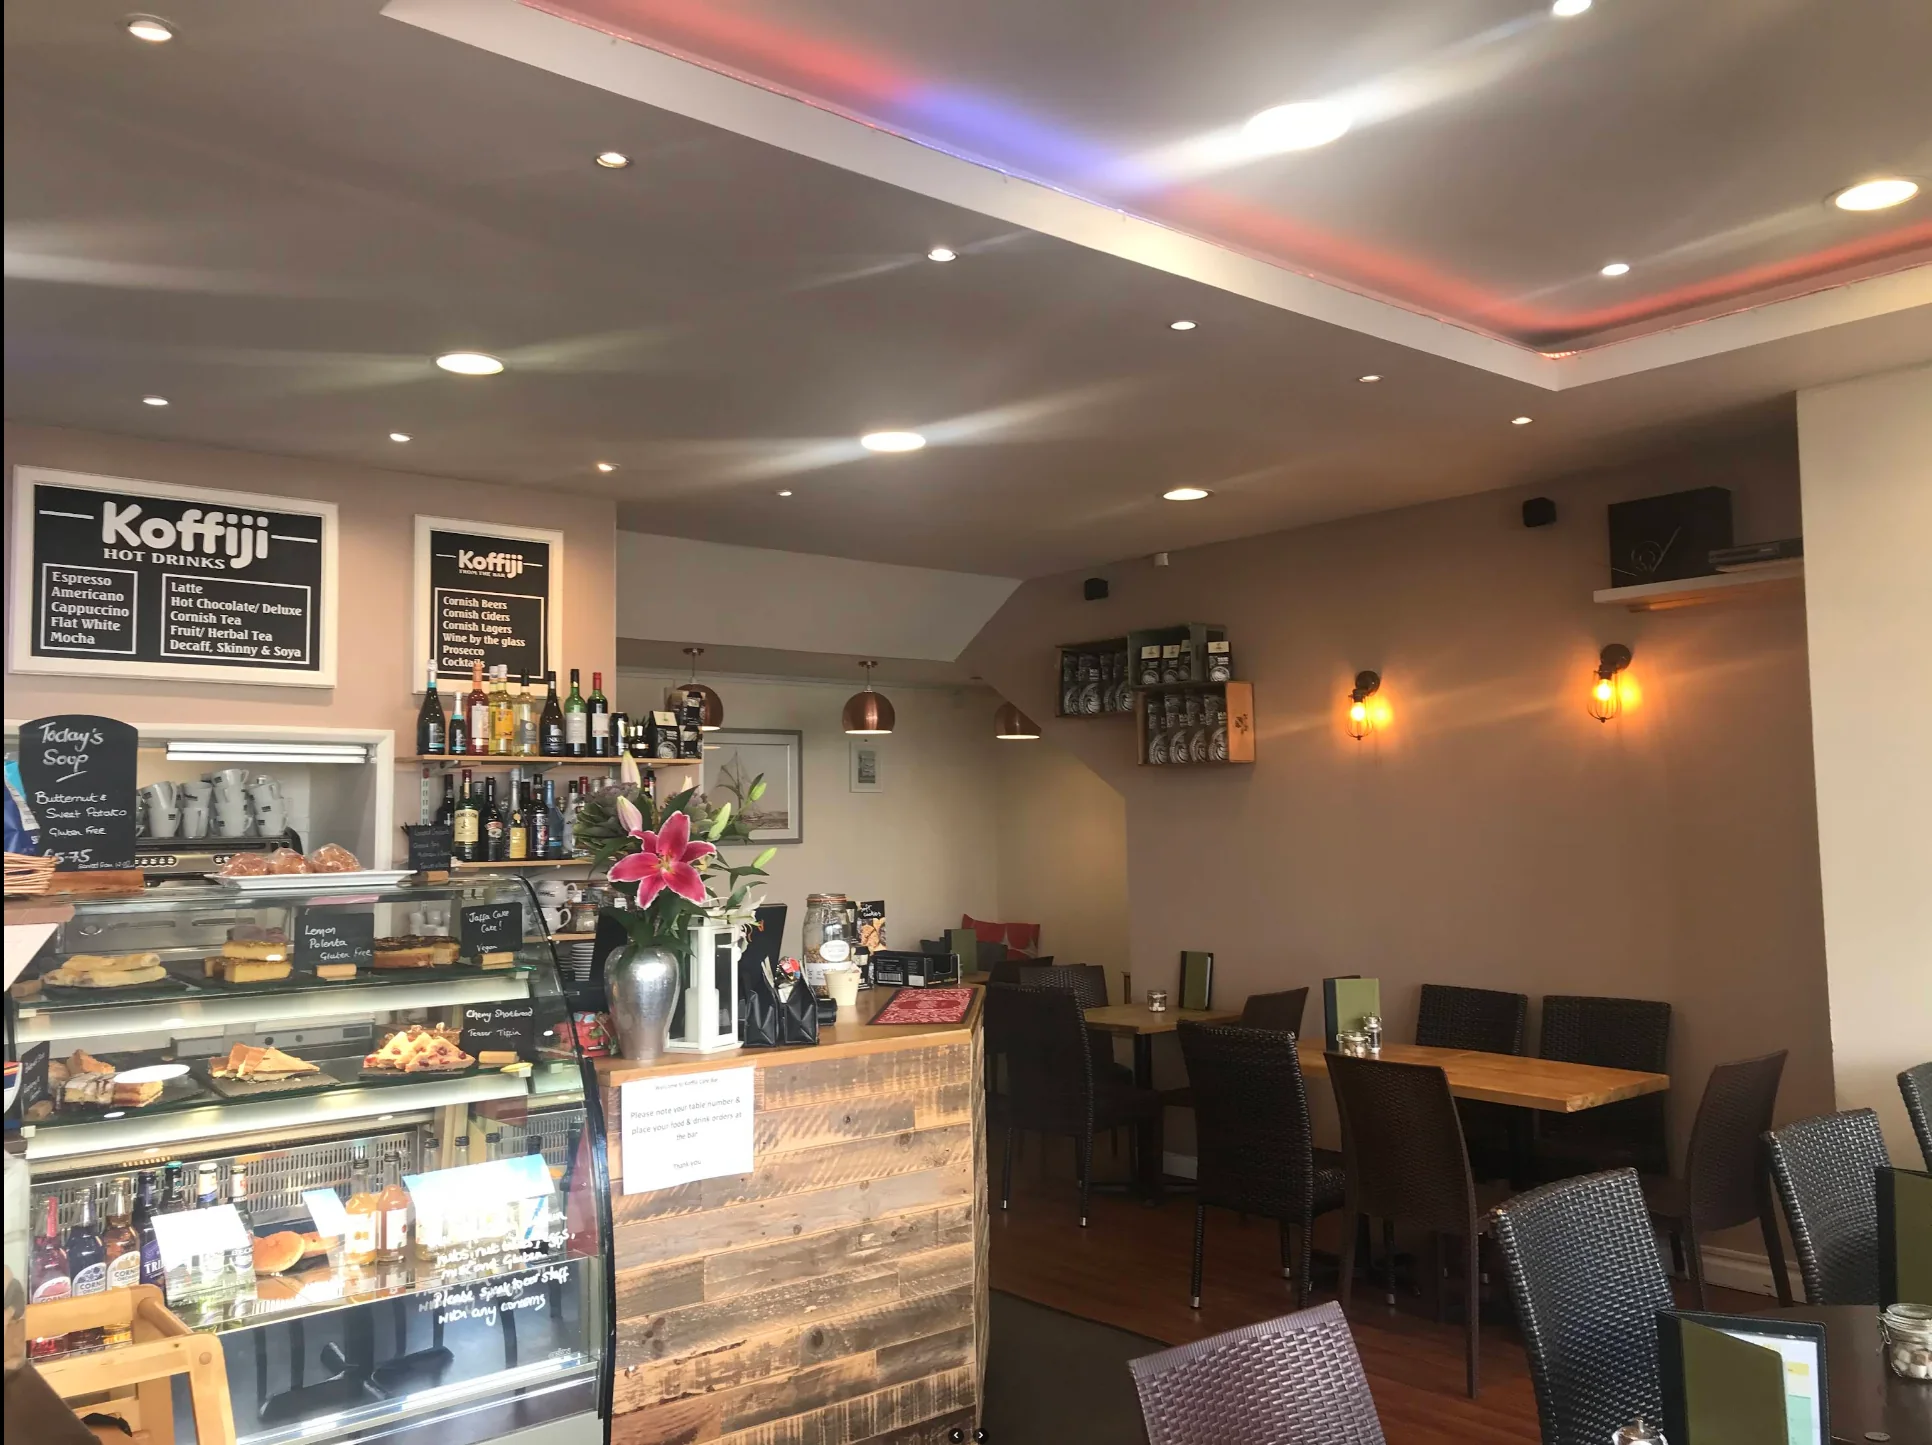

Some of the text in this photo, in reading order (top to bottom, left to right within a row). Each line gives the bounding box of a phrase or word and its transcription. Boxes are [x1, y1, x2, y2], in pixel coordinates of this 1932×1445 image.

[102, 501, 268, 569] Koffiji
[104, 548, 225, 570] HOT DRINKS
[459, 550, 523, 578] Koffiji
[52, 572, 112, 587] Espresso
[51, 587, 124, 601] Americano
[171, 582, 203, 594] Latte
[171, 597, 302, 616] Hot Chocolate/ Deluxe
[443, 596, 507, 609] Cornish Beers
[51, 602, 129, 618] Cappuccino
[443, 608, 510, 622] Cornish Ciders
[51, 617, 120, 631] Flat White
[170, 611, 242, 626] Cornish Tea
[170, 625, 273, 642] Fruit/ Herbal Tea
[443, 620, 512, 634] Cornish Lagers
[50, 632, 95, 645] Mocha
[443, 632, 526, 647] Wine by the glass
[170, 640, 301, 659] Decaff, Skinny & Soya
[443, 645, 485, 656] Prosecco
[39, 722, 104, 752] Today's
[42, 749, 89, 772] Soup
[35, 791, 99, 804] Butternut
[46, 807, 127, 818] Sweet Potato
[49, 826, 107, 838] Gluten Free
[469, 910, 510, 923] Jaffa Cake
[305, 925, 336, 937] Lemon
[309, 938, 347, 949] Polenta
[476, 943, 498, 953] Vegan
[320, 947, 373, 960] Gluten Free
[631, 1110, 654, 1119] Please
[656, 1107, 672, 1115] note
[674, 1105, 687, 1114] your
[689, 1102, 706, 1110] table
[707, 1098, 734, 1107] number
[632, 1111, 742, 1135] place your food & drink orders at
[676, 1133, 686, 1141] the
[673, 1161, 689, 1170] Thank
[114, 1270, 136, 1278] CORN
[144, 1260, 161, 1274] TRI
[471, 1306, 497, 1327] any
